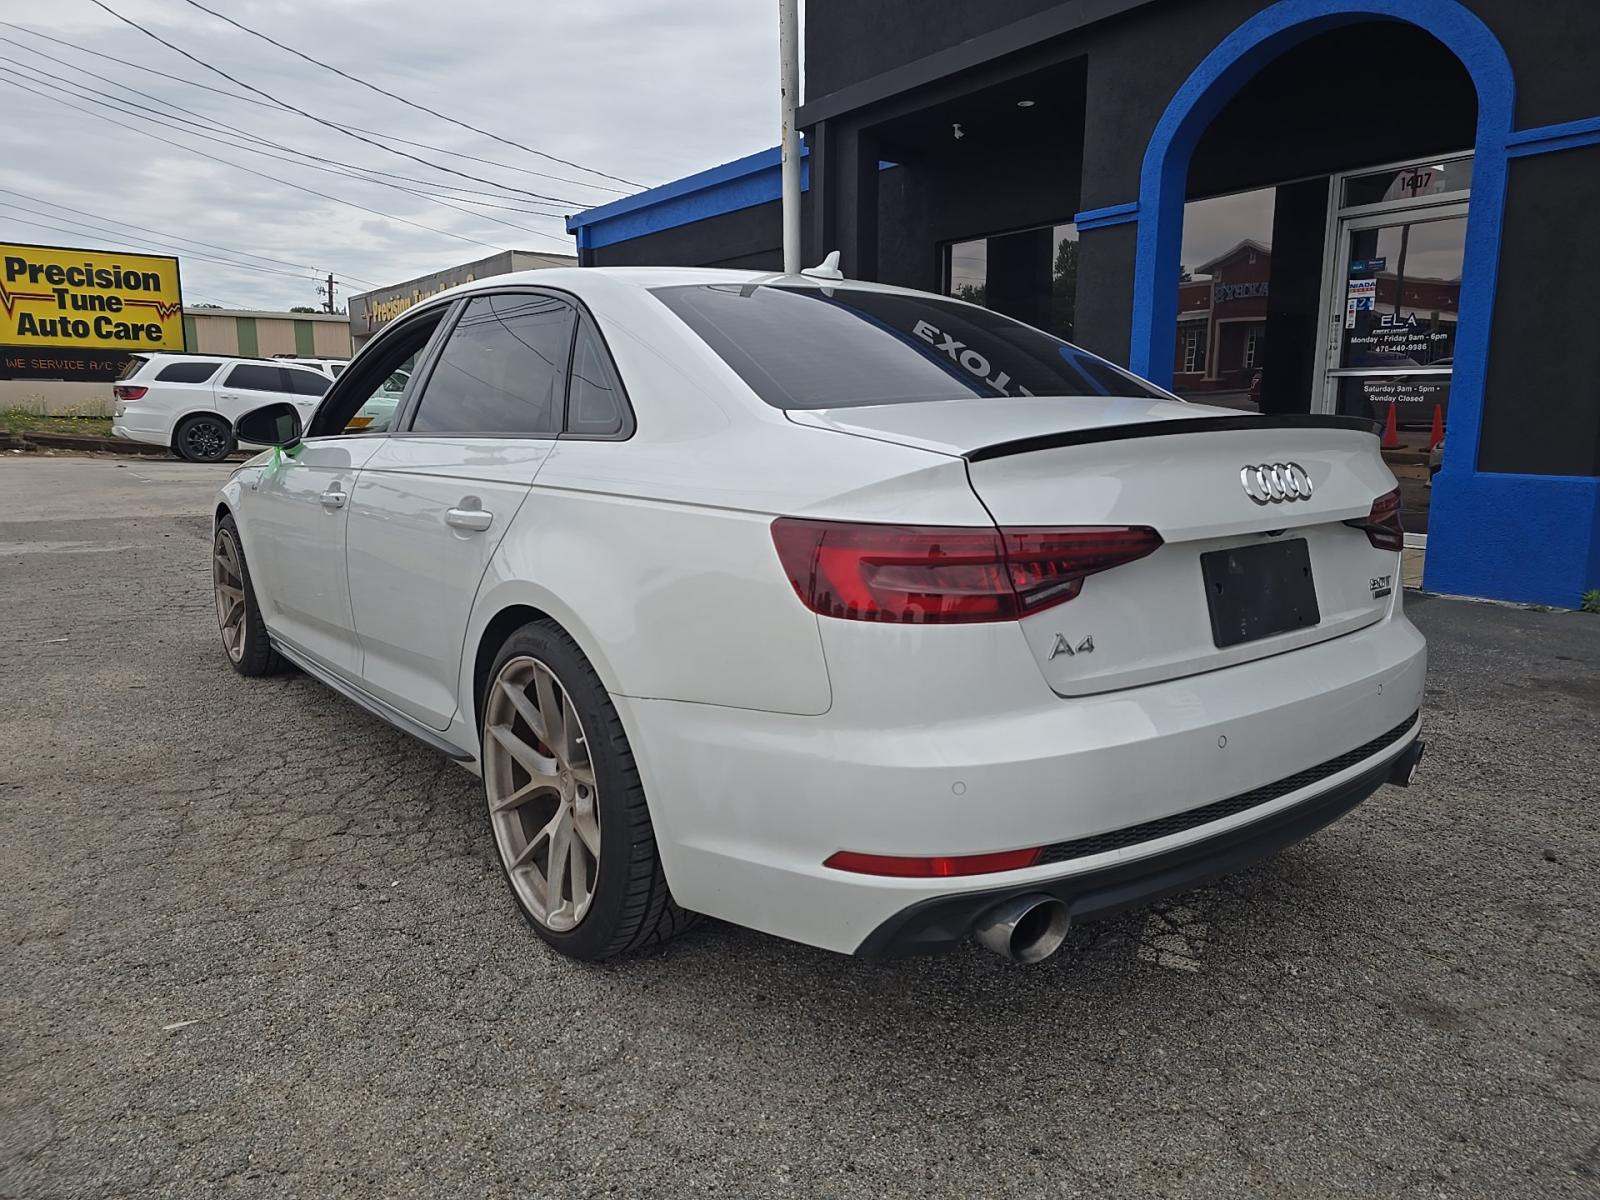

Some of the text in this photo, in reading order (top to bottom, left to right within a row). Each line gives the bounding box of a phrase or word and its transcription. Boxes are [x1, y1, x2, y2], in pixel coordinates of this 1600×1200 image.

[1402, 172, 1431, 191] 1407
[5, 256, 161, 292] Precision
[52, 287, 124, 312] Tune
[17, 312, 163, 341] Auto Care
[1351, 335, 1378, 344] Monday
[1384, 334, 1408, 343] Friday
[1408, 334, 1424, 342] 9am
[1430, 333, 1448, 342] 6pm
[6, 358, 26, 369] WE
[30, 359, 85, 370] SERVICE
[89, 360, 113, 371] A/C
[1363, 386, 1395, 394] Saturday
[1369, 394, 1425, 402] Sunday Closed
[1048, 631, 1096, 661] A4
